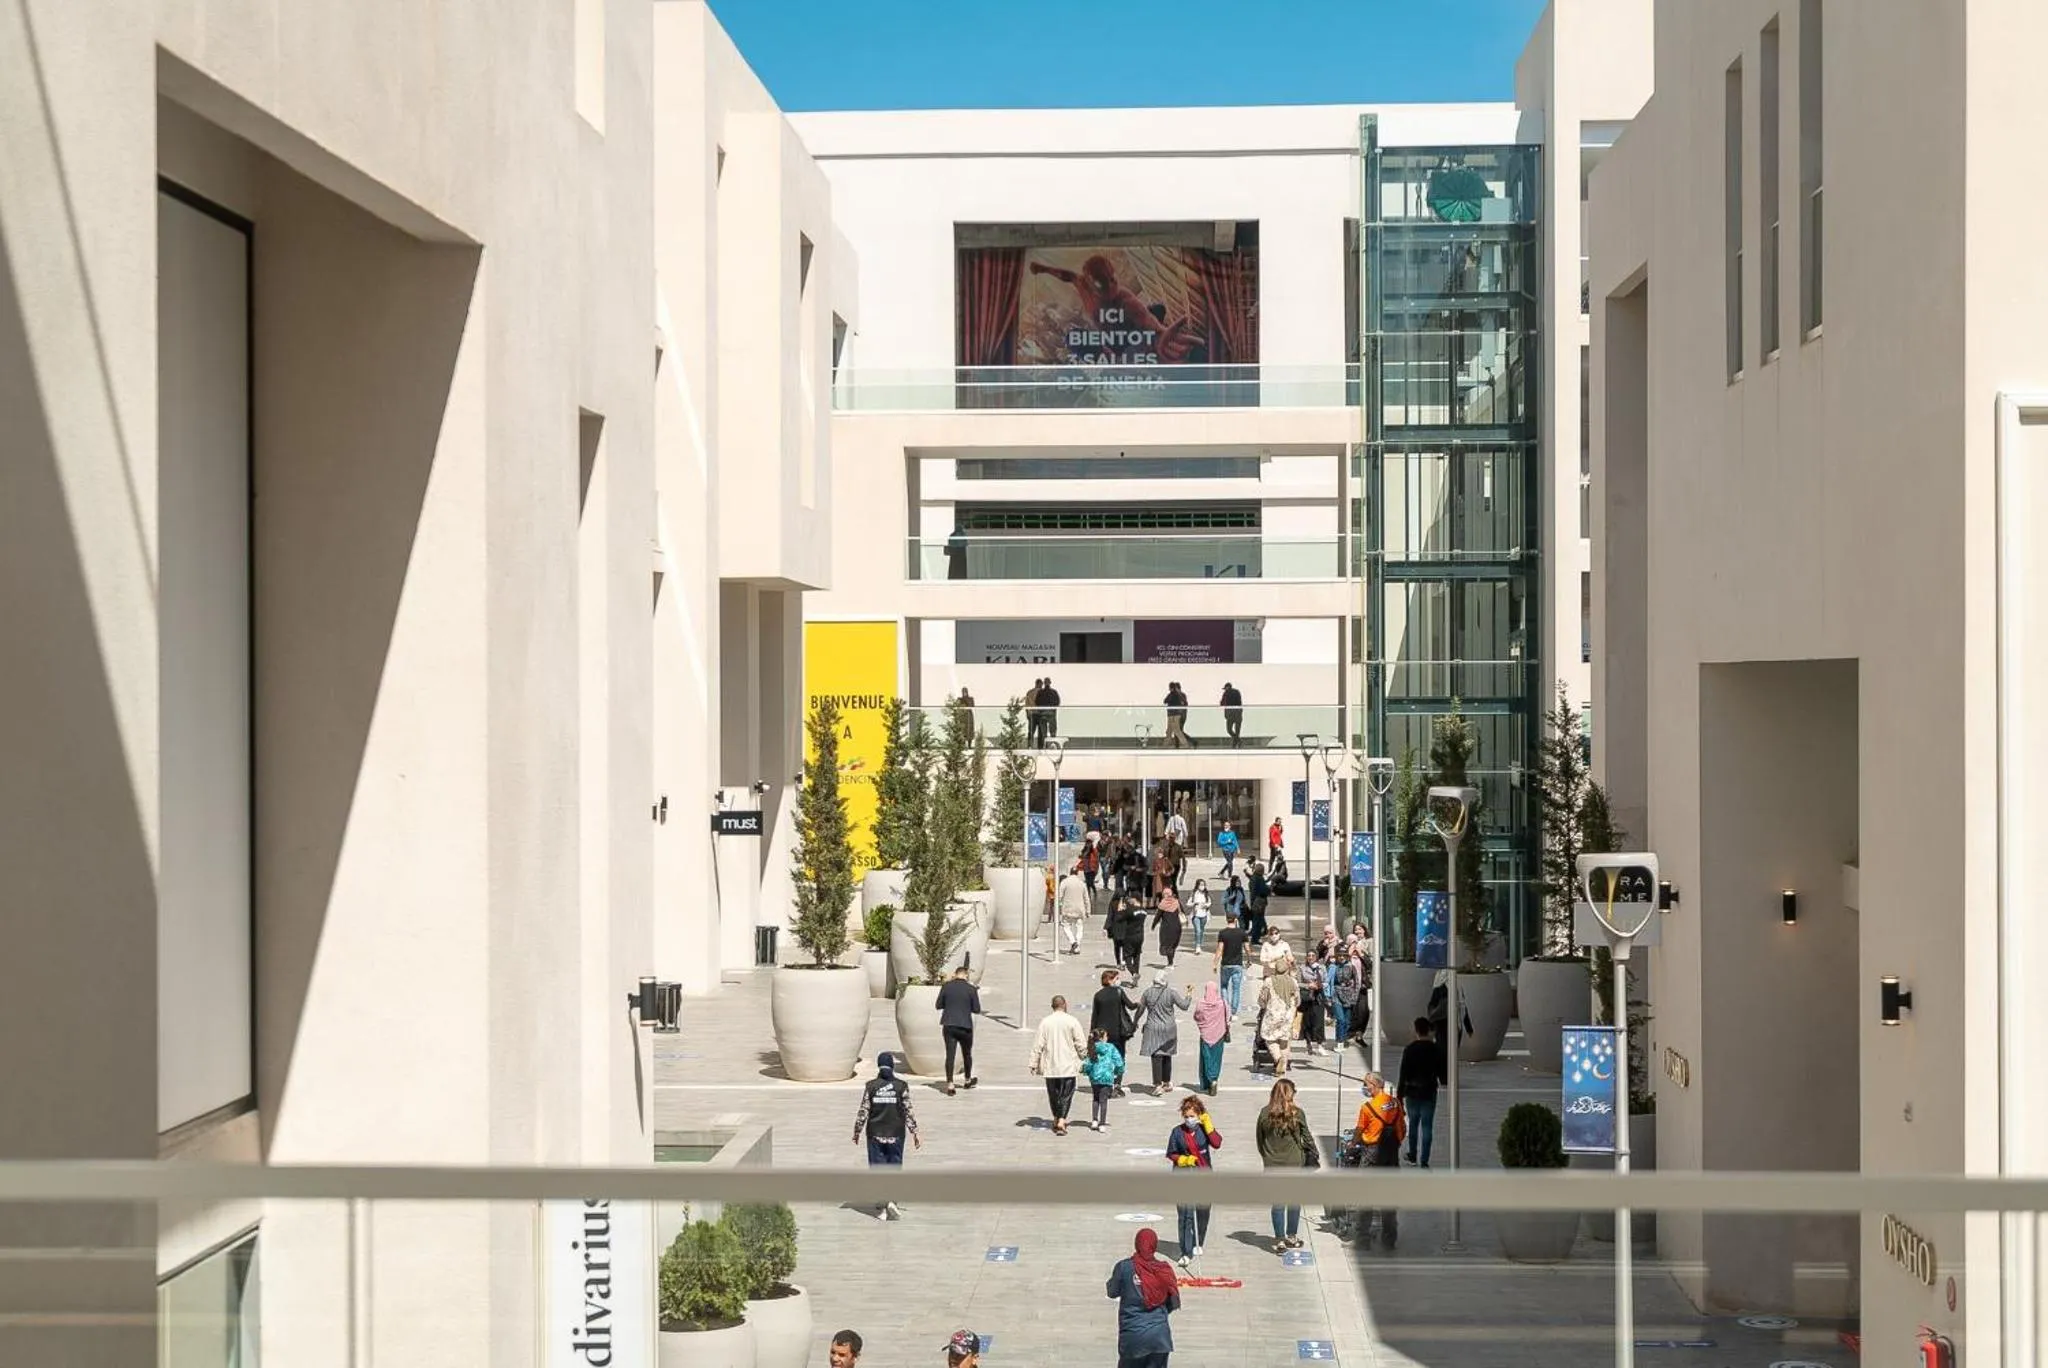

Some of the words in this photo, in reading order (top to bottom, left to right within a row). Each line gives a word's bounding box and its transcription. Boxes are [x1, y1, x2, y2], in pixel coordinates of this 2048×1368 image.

[1099, 308, 1125, 323] ICI
[1068, 330, 1156, 346] BIENTOT
[1067, 353, 1079, 367] 3
[1083, 352, 1158, 367] SALLES
[1057, 376, 1084, 390] DE
[811, 695, 885, 710] BIENVENUE
[723, 817, 758, 829] must
[1881, 1214, 1931, 1287] OYSHO
